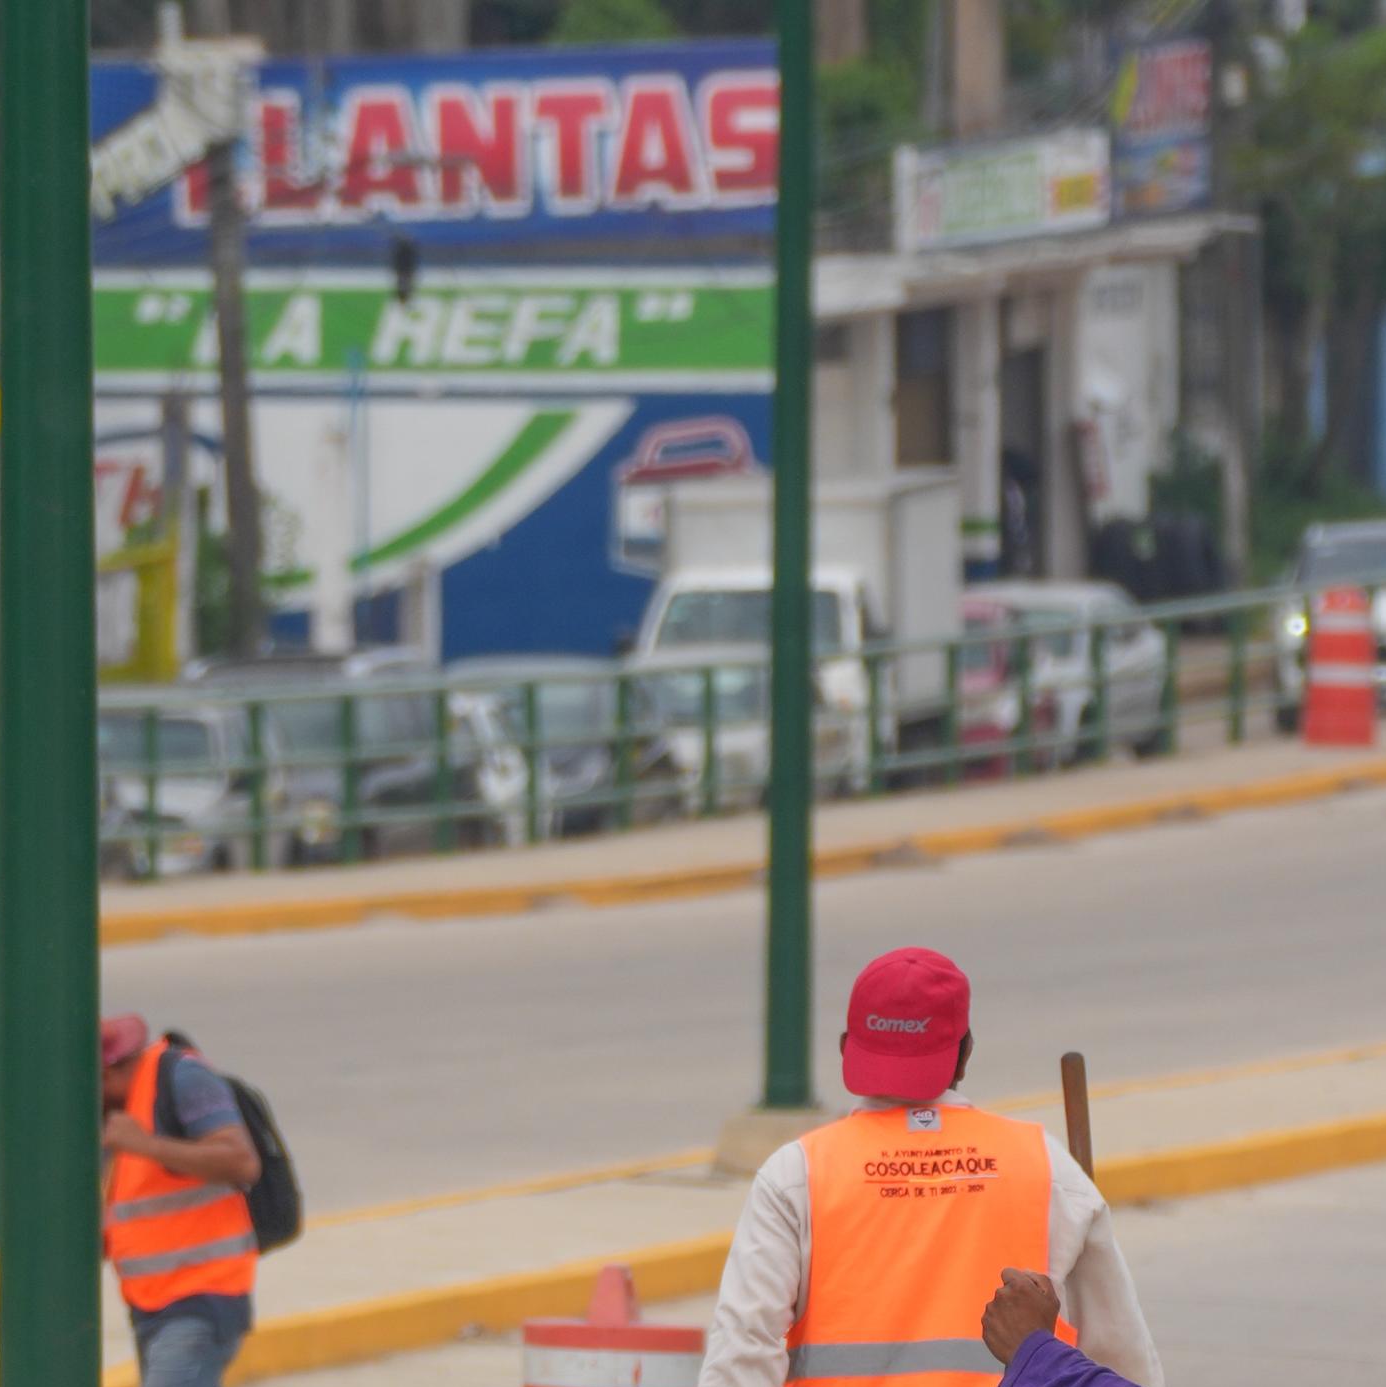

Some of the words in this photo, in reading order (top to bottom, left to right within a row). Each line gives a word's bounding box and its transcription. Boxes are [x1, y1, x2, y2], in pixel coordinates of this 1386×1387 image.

[865, 1013, 933, 1034] Comex
[864, 1158, 998, 1177] COSOLEACAQUE
[880, 1186, 910, 1198] CERCA
[914, 1186, 926, 1198] DE
